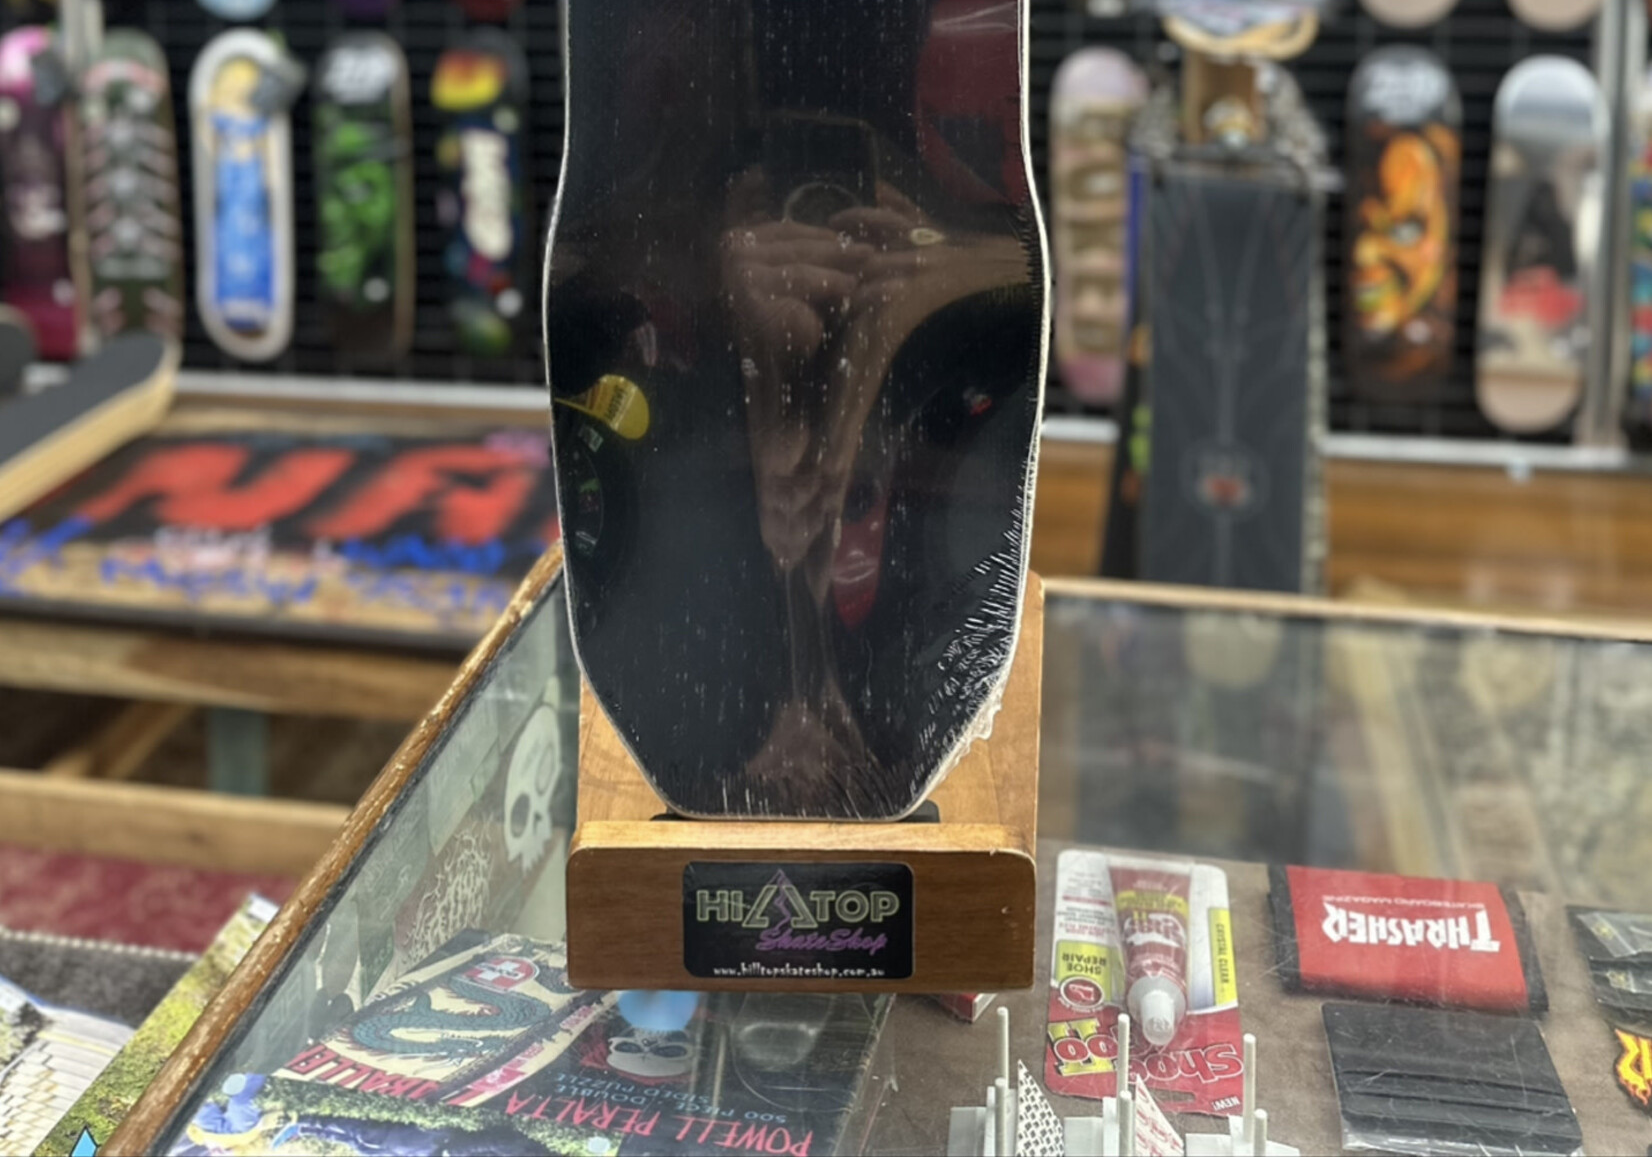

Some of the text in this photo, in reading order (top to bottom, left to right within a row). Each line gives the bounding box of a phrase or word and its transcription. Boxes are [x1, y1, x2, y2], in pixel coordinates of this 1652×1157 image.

[1321, 901, 1501, 953] THRASHER
[1061, 952, 1108, 966] REPAIR
[713, 962, 885, 979] www.hilltopskateshop.com.au
[1066, 963, 1102, 976] SHOE
[1212, 1095, 1241, 1112] NEW!
[504, 1090, 813, 1157] POWELL PERALTA
[744, 1110, 787, 1124] 500
